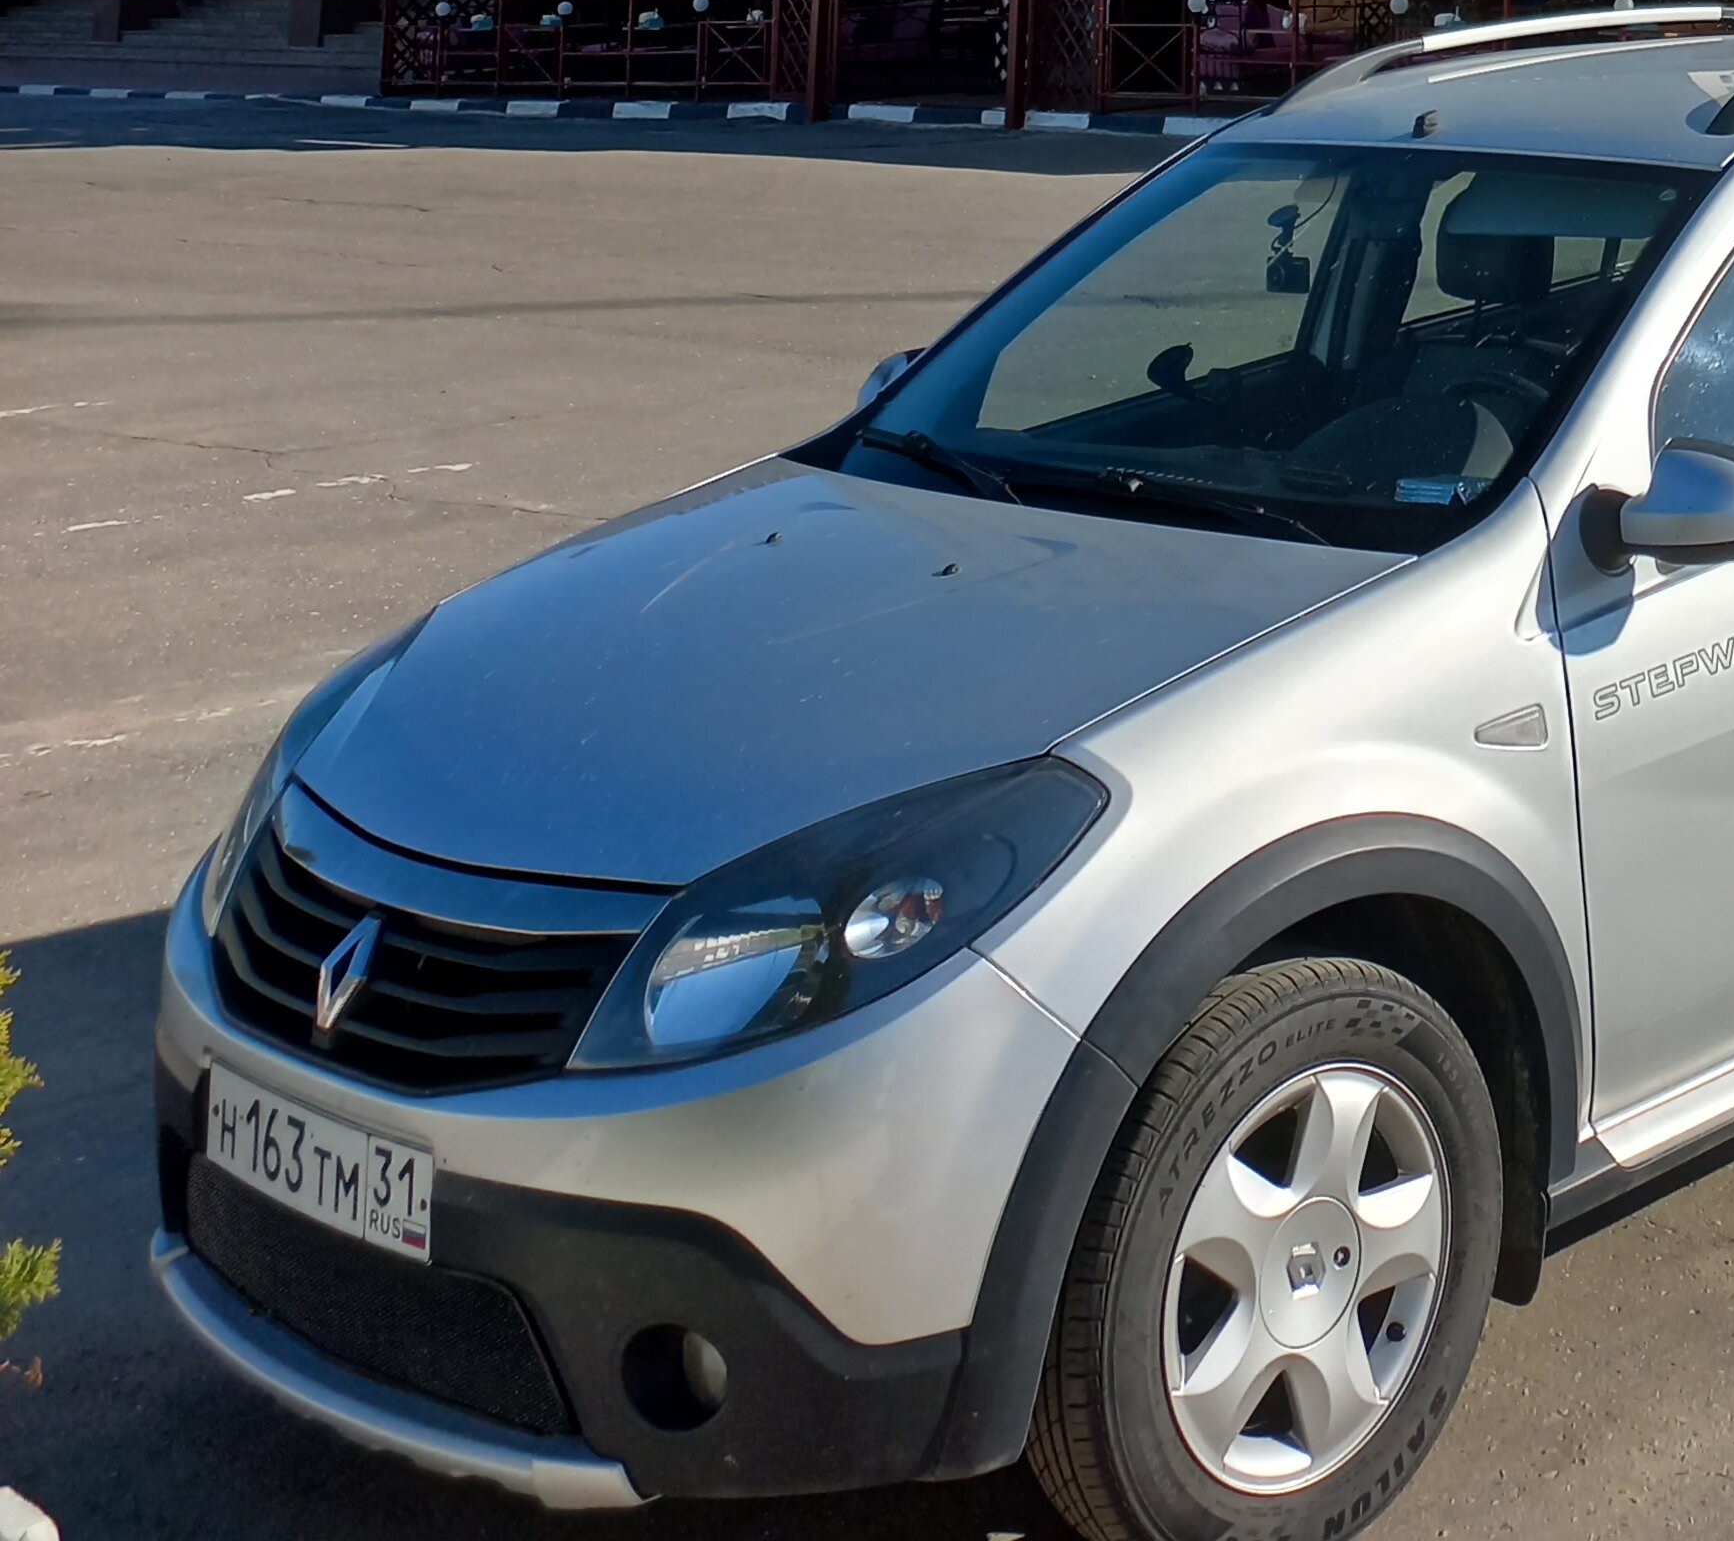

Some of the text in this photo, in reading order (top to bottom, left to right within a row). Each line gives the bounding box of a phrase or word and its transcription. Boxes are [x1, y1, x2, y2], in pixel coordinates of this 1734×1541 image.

[1159, 1018, 1336, 1219] ATREZZO ELITE
[371, 1146, 419, 1217] 31
[368, 1208, 402, 1240] RUS
